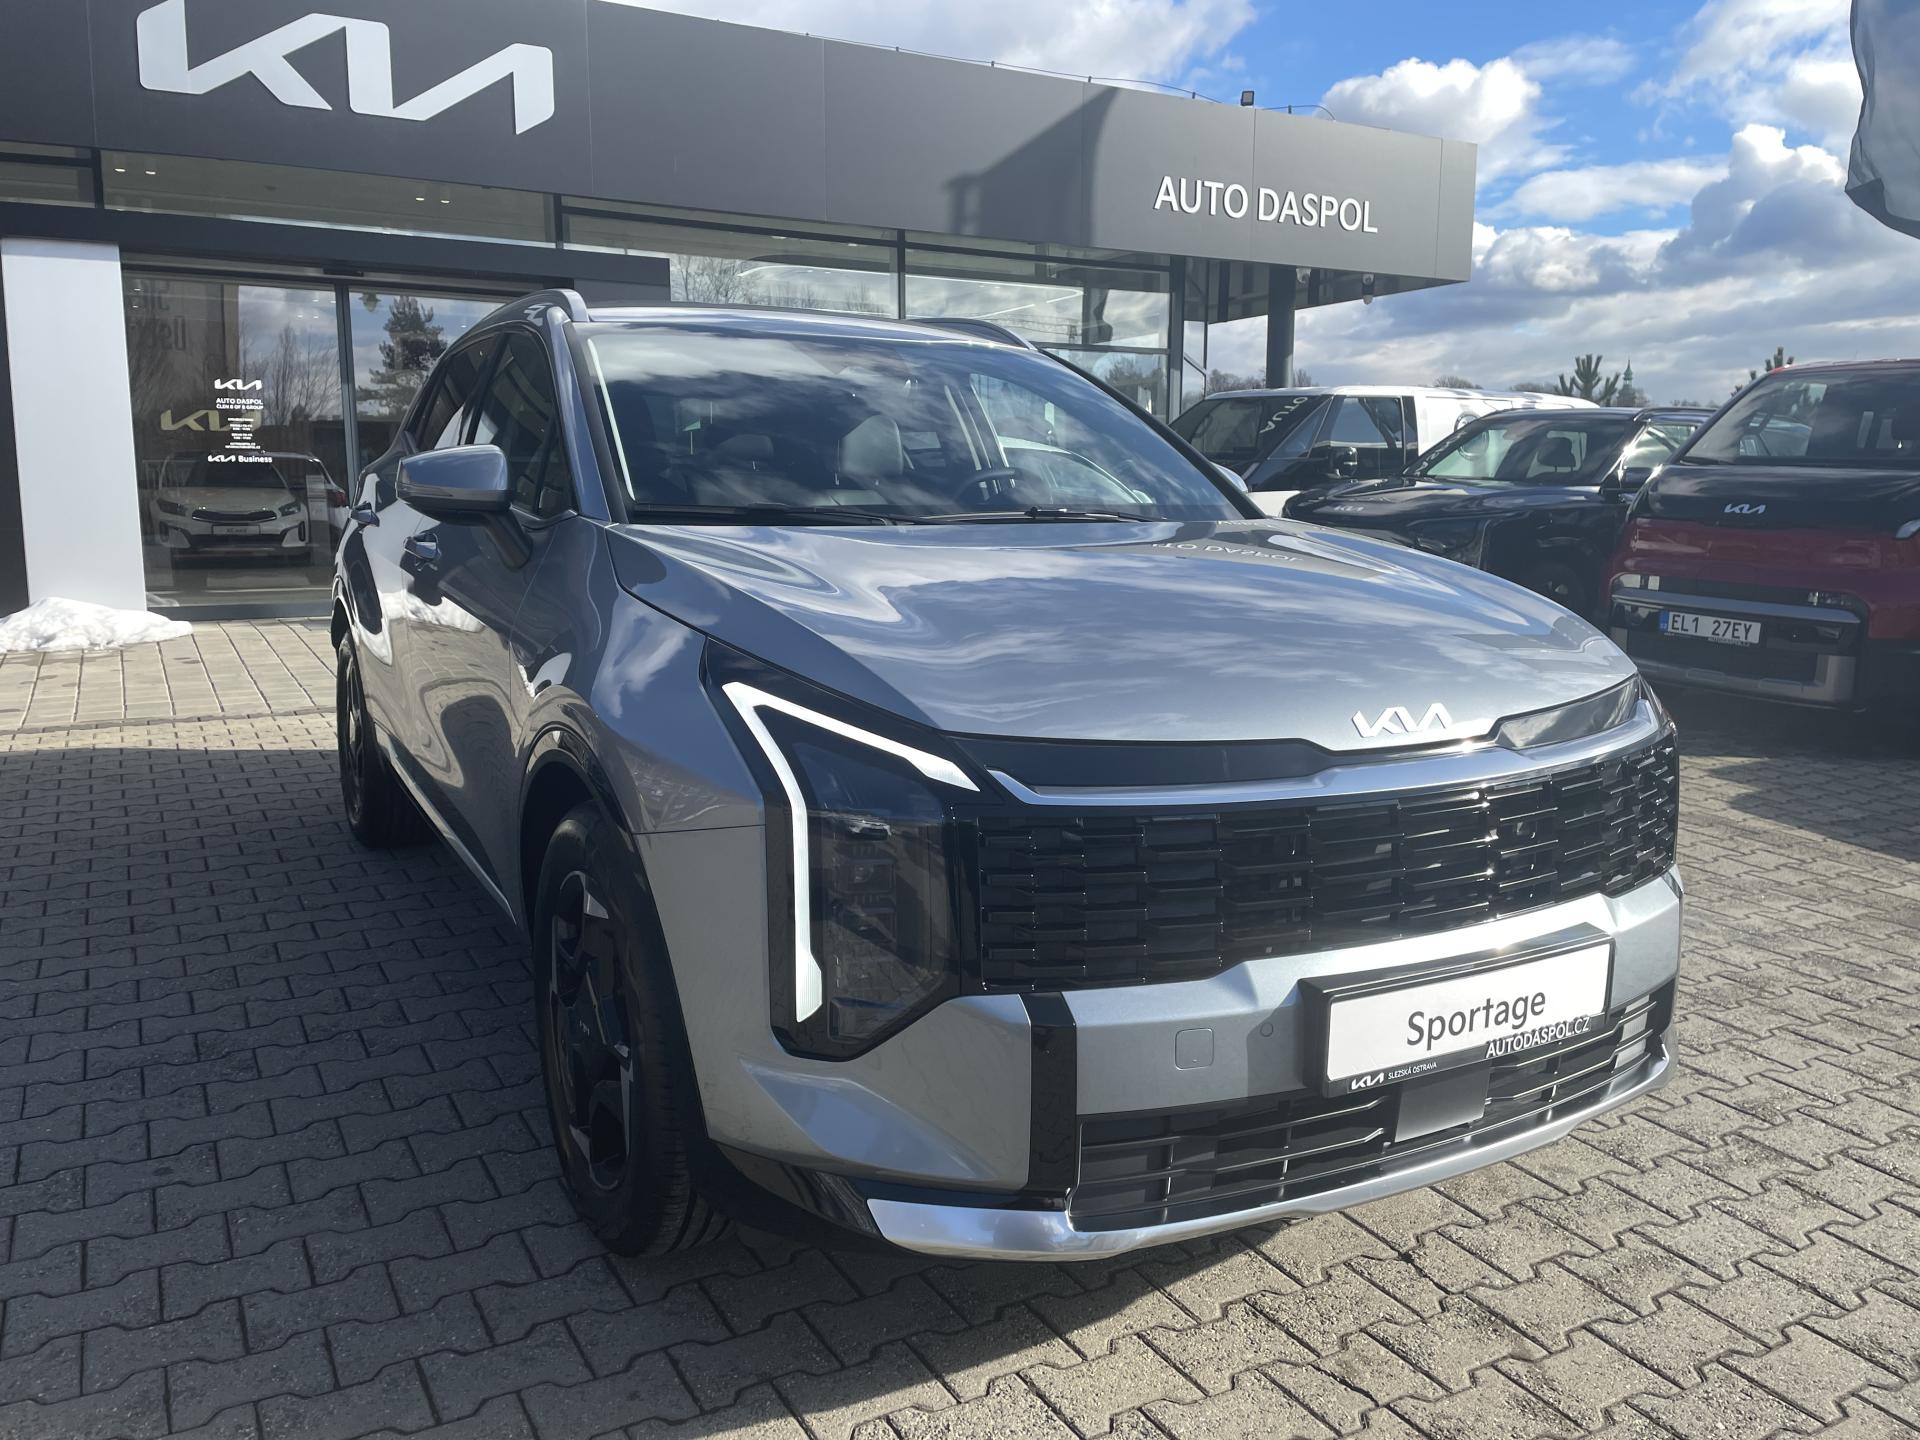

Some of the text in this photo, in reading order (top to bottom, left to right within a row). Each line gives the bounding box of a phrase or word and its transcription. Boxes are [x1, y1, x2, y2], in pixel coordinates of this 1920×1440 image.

[136, 0, 555, 134] KIA
[1153, 175, 1378, 233] AUTO DASPOL
[214, 379, 262, 390] KIA
[238, 455, 272, 463] Business
[1724, 503, 1766, 514] KIA
[1671, 614, 1752, 640] EL1 27EY
[1351, 702, 1452, 738] KIA
[1407, 992, 1546, 1051] Sportage
[1485, 1015, 1591, 1058] AUTODASPOL.CZ
[1351, 1061, 1437, 1090] KIA SLEZSKÁ OSTRAVA
